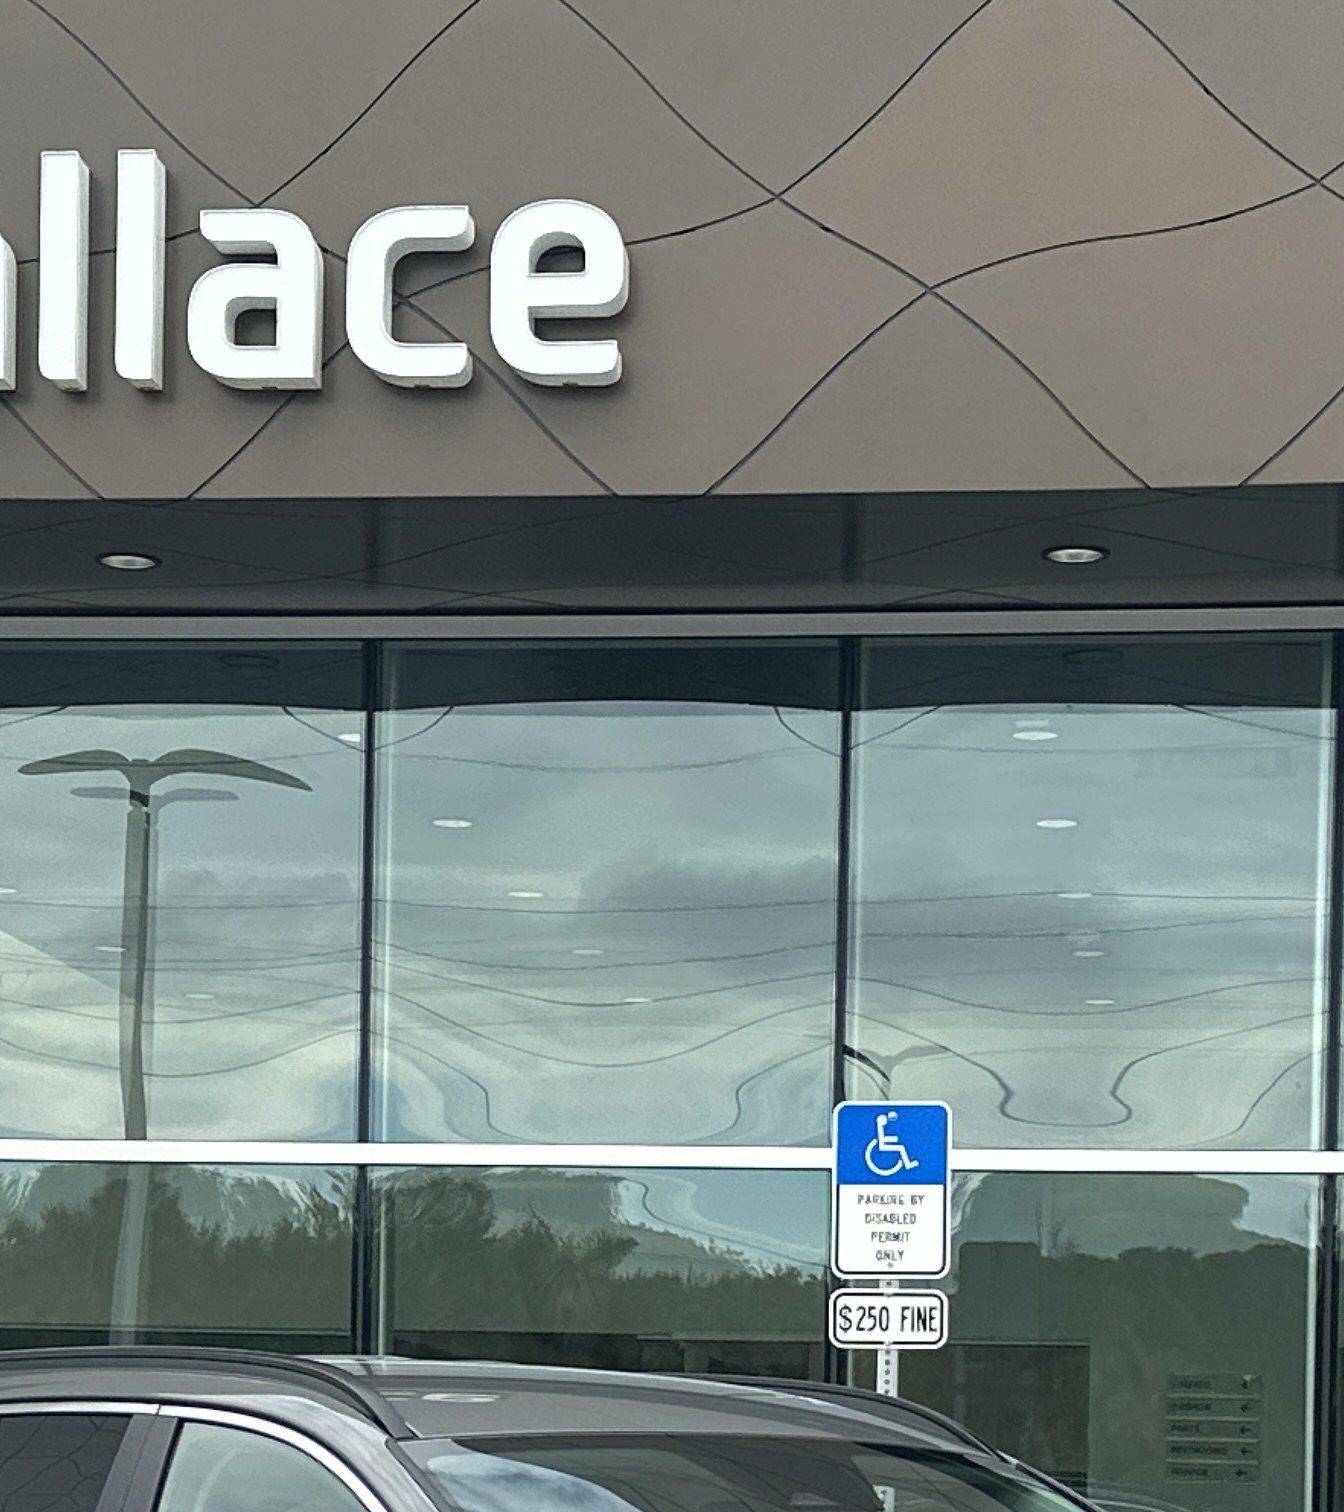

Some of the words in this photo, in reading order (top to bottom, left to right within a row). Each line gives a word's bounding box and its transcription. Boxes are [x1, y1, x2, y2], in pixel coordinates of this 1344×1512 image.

[856, 1194, 905, 1205] PARKING
[910, 1194, 925, 1205] BY
[864, 1212, 917, 1224] DISABLED
[870, 1231, 911, 1243] PERMIT
[875, 1249, 905, 1261] ONLY
[838, 1304, 890, 1334] $250
[900, 1306, 938, 1333] FINE
